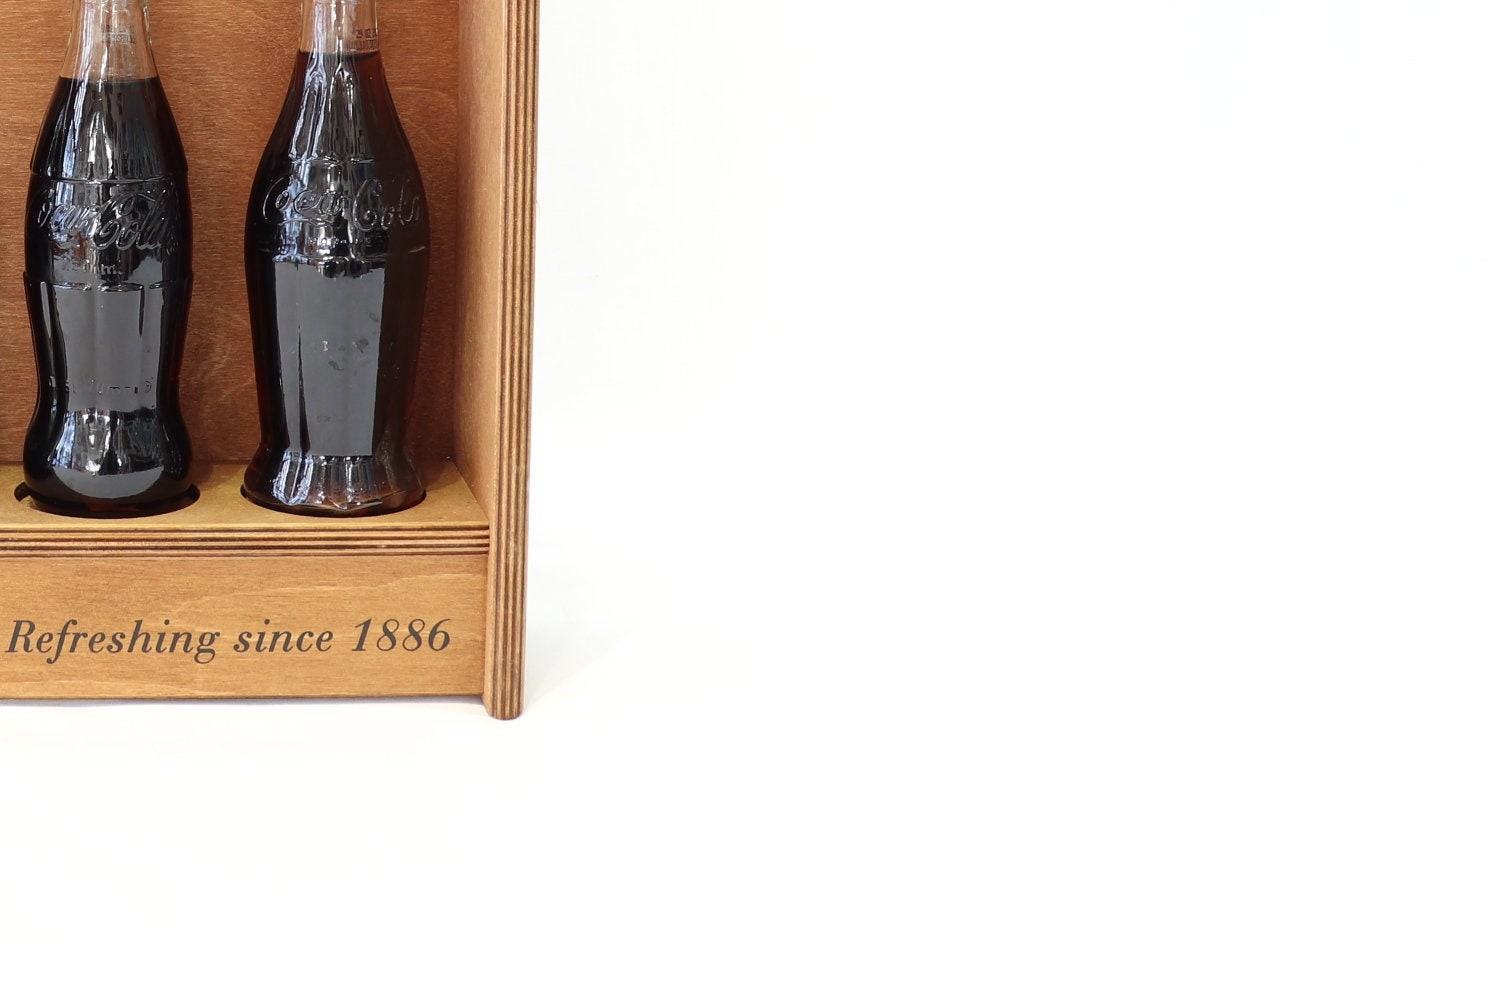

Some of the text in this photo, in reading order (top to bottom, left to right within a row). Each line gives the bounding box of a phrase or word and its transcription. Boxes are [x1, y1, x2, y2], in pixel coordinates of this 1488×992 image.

[5, 618, 220, 665] Refreshing
[233, 618, 334, 653] since
[351, 617, 452, 652] 1886
